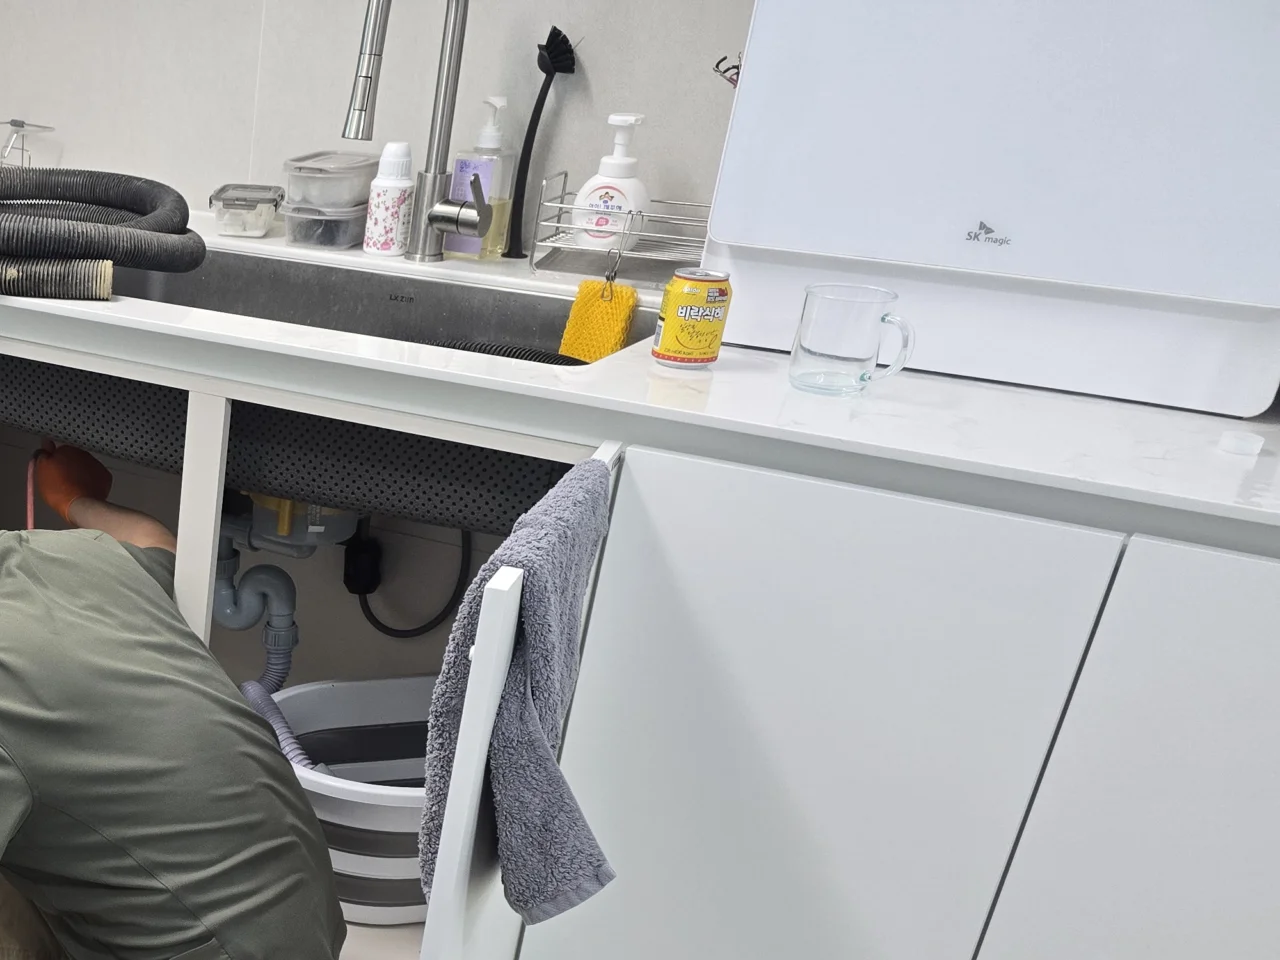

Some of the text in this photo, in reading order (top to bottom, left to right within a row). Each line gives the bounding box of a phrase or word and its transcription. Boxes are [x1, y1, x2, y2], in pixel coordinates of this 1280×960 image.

[965, 231, 1012, 247] SK magic
[677, 304, 725, 322] 비락식혜
